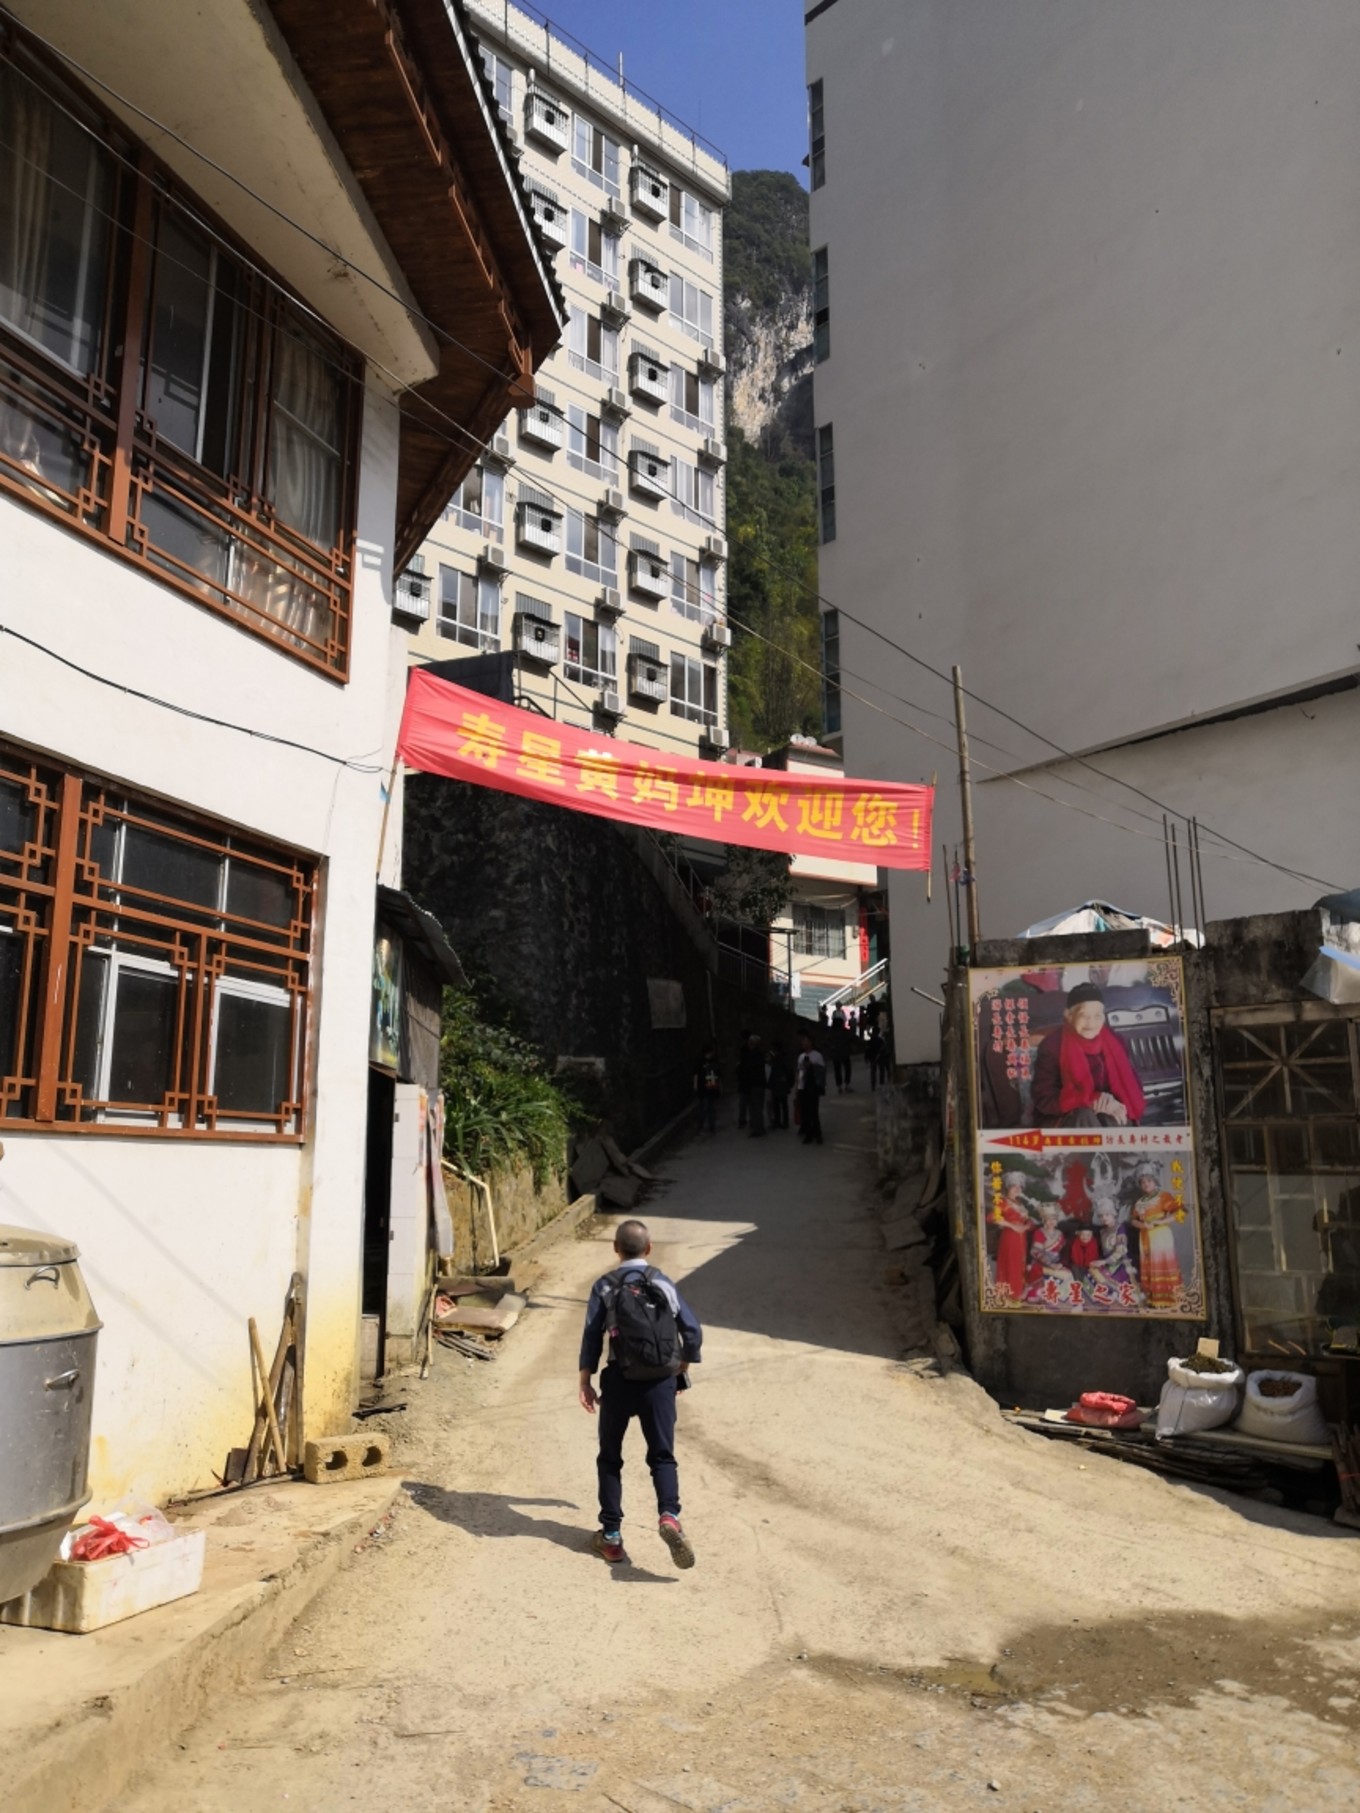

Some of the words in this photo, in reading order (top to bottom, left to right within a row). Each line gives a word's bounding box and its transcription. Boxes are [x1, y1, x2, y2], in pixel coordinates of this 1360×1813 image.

[455, 710, 921, 850] 寿星黄妈坤欢迎您！
